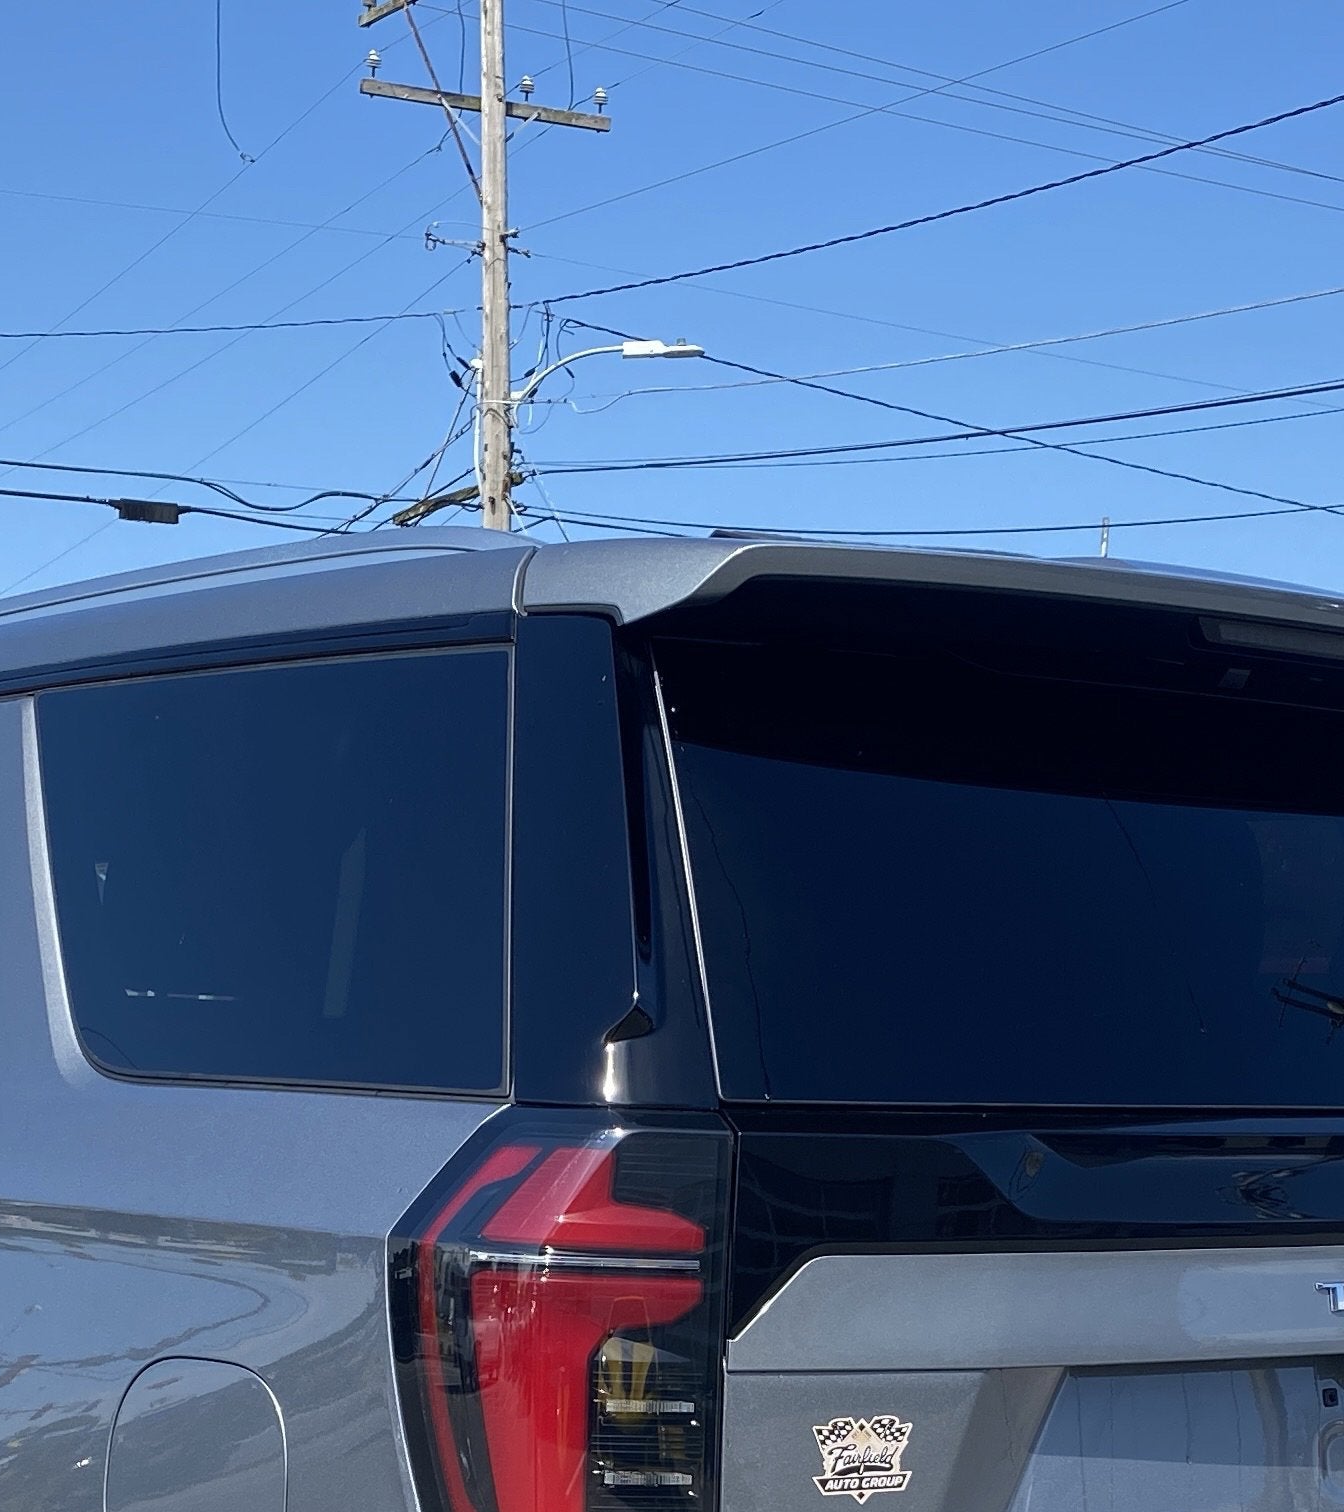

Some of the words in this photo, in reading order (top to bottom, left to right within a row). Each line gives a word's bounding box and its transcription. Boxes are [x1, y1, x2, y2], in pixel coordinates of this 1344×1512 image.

[827, 1444, 898, 1475] Fairfield
[825, 1479, 859, 1491] AUTO
[861, 1476, 904, 1489] GROUP
